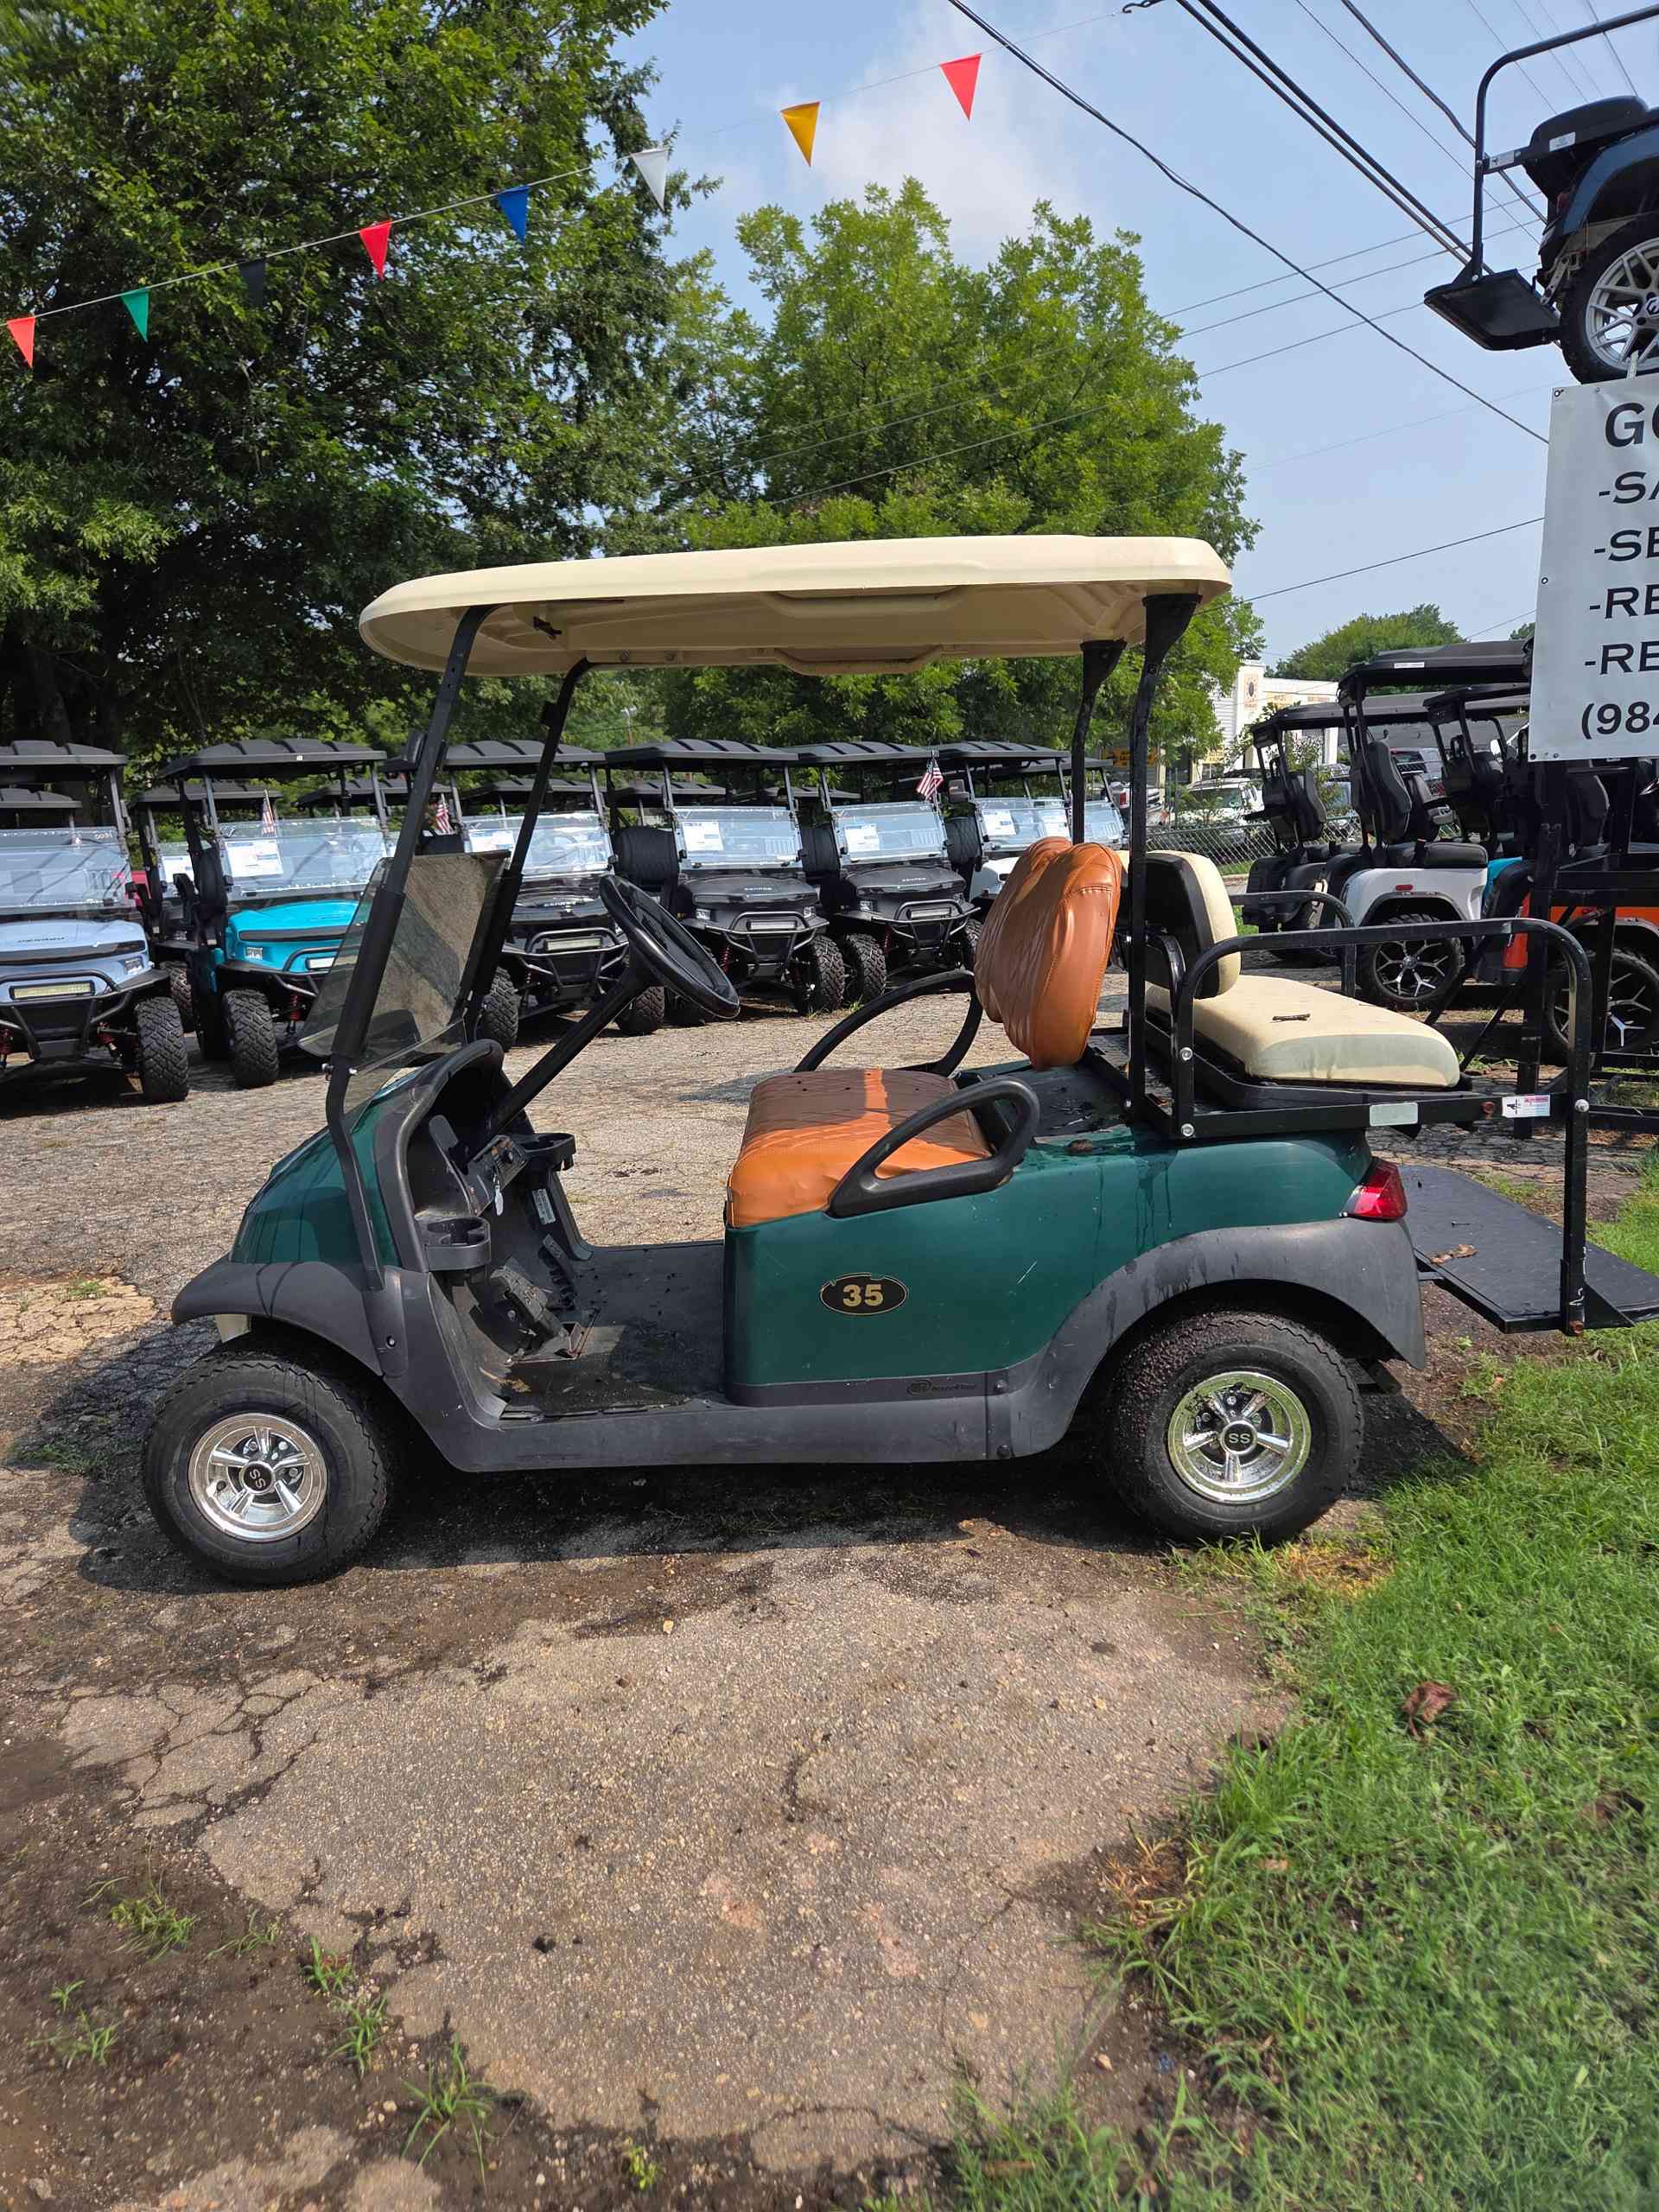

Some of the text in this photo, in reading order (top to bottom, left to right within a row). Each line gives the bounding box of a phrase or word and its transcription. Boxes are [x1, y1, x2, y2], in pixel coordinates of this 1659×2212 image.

[1605, 402, 1659, 448] G
[1585, 640, 1659, 675] -RE
[1581, 701, 1659, 740] (98
[842, 1283, 884, 1307] 35
[1229, 1433, 1251, 1444] SS
[249, 1469, 266, 1488] SS
